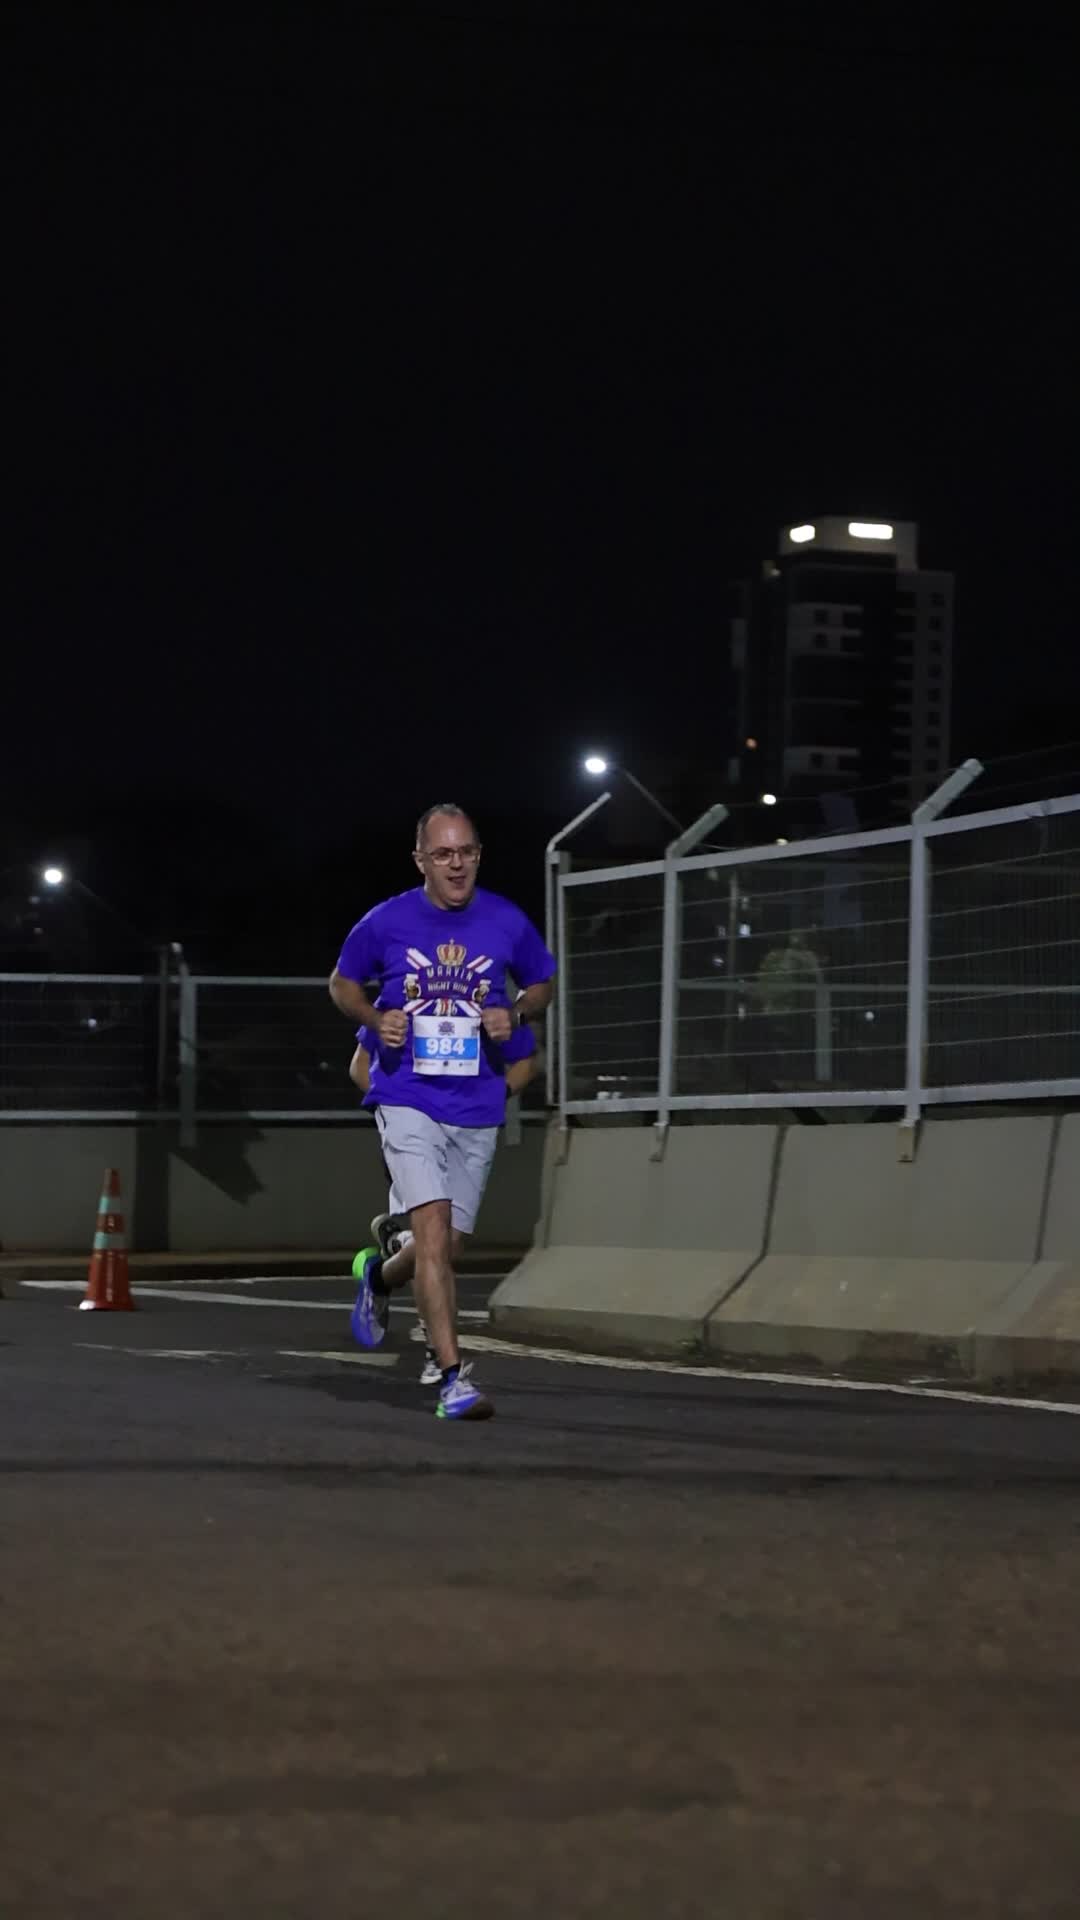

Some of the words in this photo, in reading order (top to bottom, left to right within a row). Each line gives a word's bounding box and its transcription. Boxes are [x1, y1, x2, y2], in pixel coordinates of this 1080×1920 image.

[427, 981, 450, 992] NIGHT
[452, 982, 468, 994] RUN
[426, 1038, 465, 1056] 984
